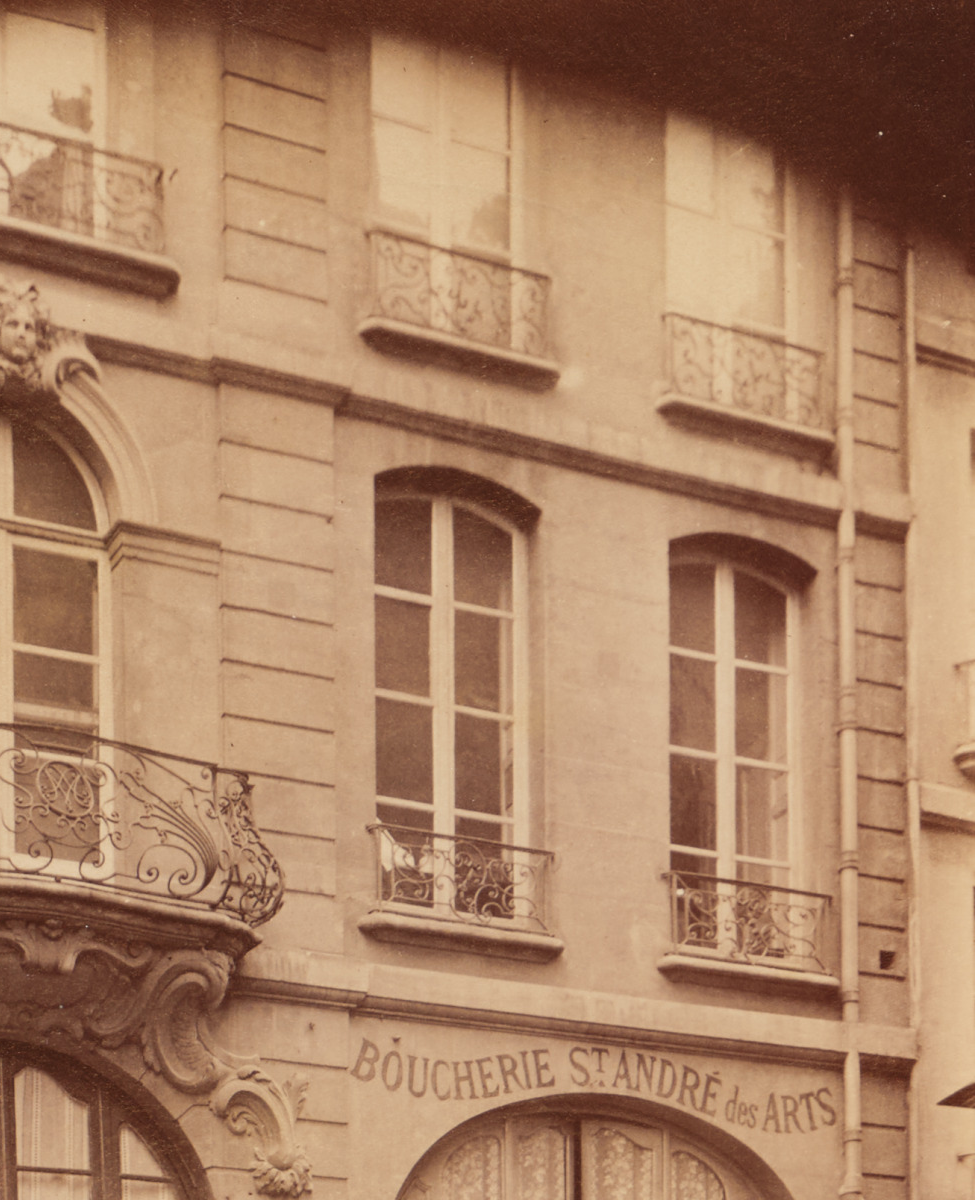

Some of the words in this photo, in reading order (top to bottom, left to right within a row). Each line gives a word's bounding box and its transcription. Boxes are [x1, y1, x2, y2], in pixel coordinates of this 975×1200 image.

[350, 1037, 556, 1101] BOUCHERIE
[612, 1049, 723, 1117] ANDRÉ
[726, 1086, 759, 1128] des
[762, 1087, 837, 1134] ARTS
